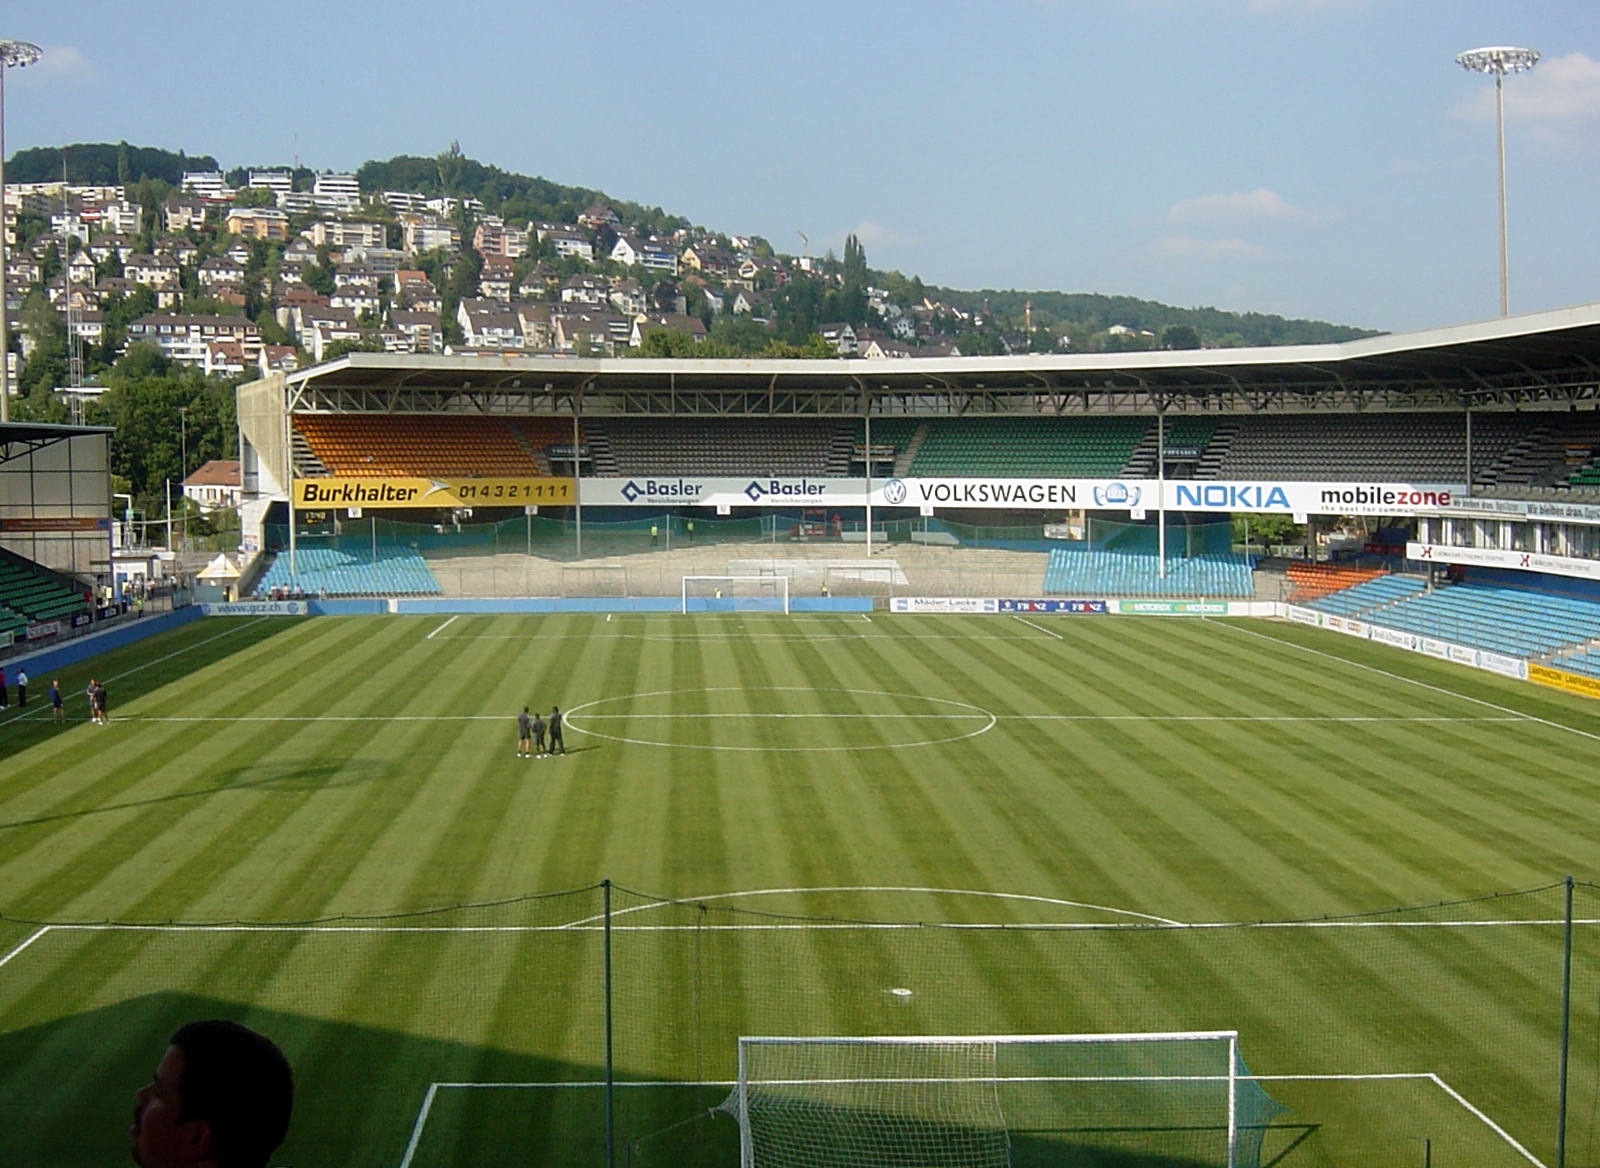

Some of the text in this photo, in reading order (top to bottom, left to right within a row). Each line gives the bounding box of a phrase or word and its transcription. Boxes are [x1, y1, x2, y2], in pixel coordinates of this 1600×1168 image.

[303, 483, 418, 501] Burkhalter
[646, 479, 703, 495] Basler
[769, 479, 826, 495] Basler
[919, 484, 1076, 503] VOLKSWAGEN
[1321, 486, 1451, 506] mobilezone
[1176, 485, 1291, 509] NOKIA
[217, 602, 281, 614] www.gcz.ch
